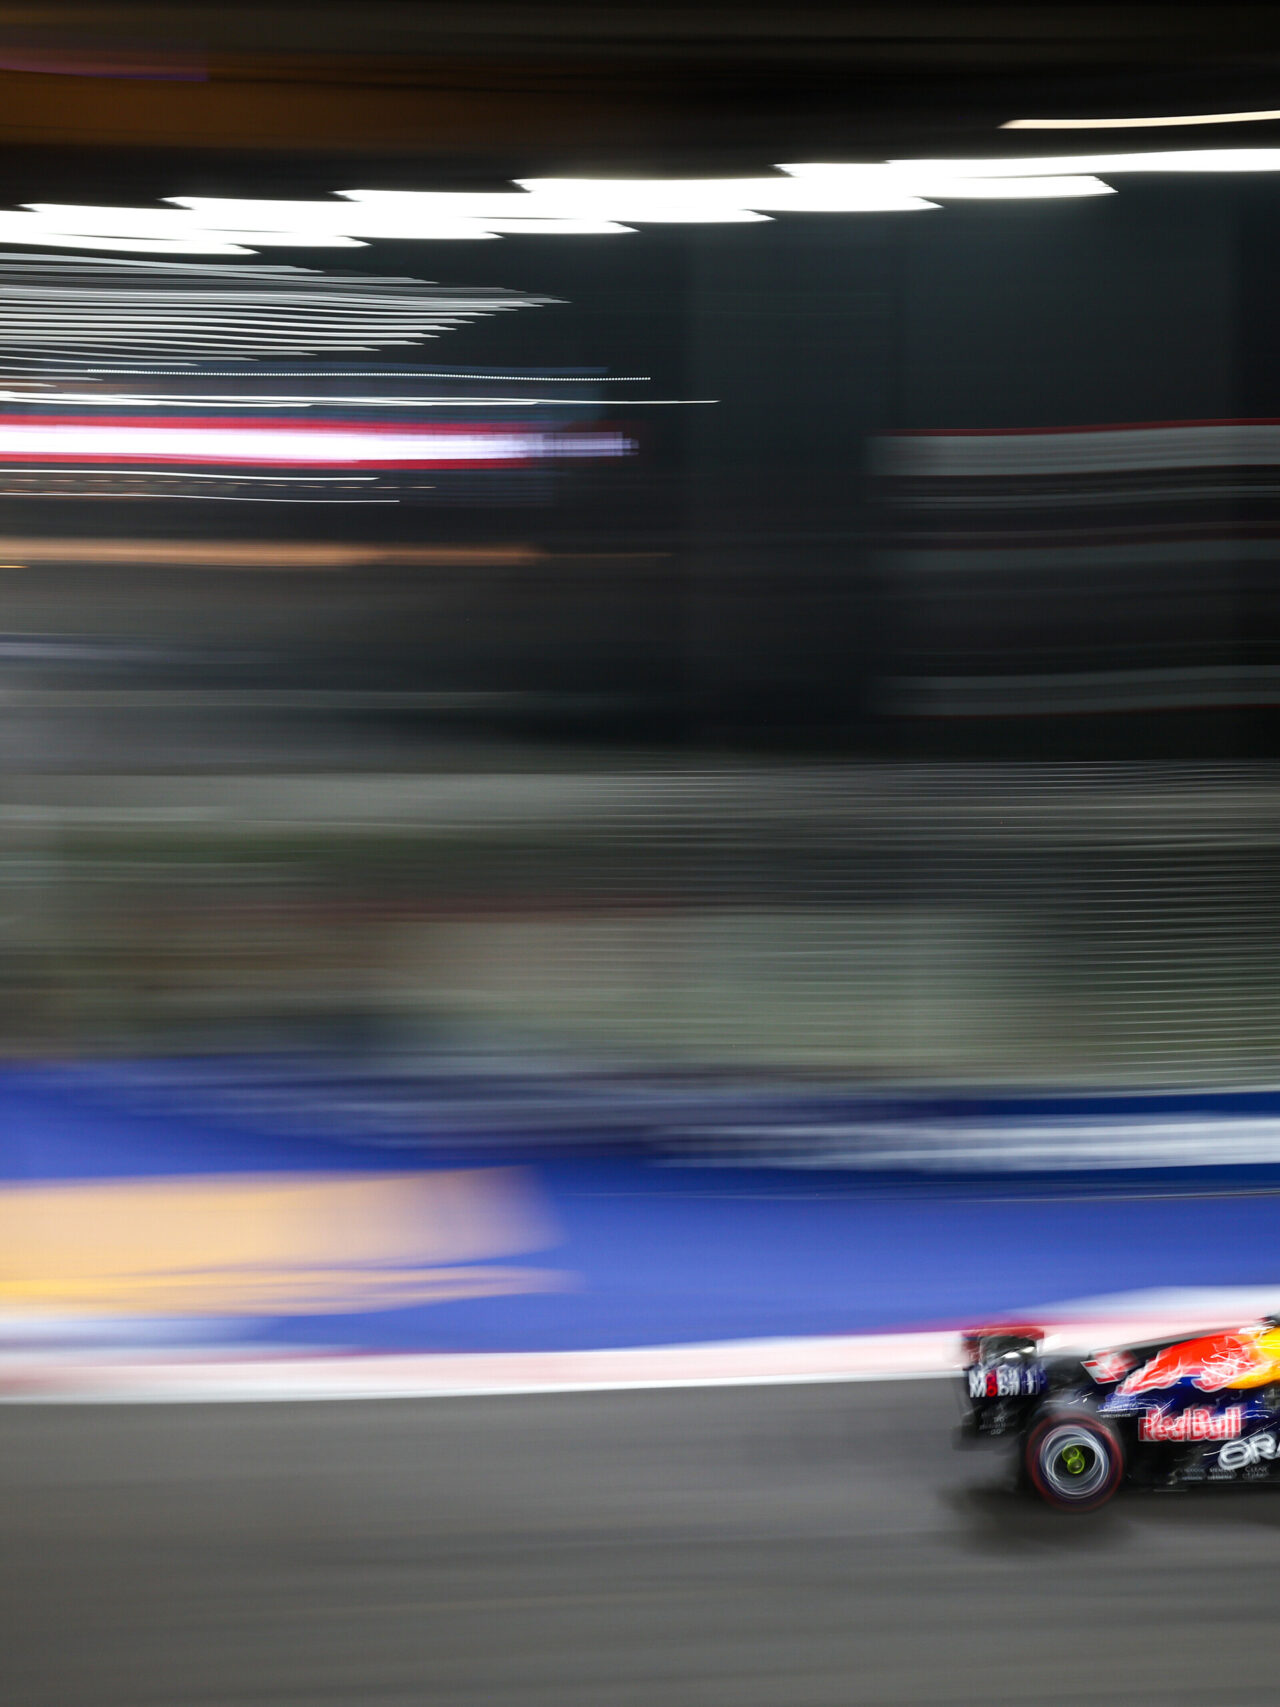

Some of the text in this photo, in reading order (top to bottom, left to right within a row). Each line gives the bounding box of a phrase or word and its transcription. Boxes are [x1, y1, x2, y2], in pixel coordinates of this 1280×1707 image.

[968, 1366, 1020, 1398] Mobil
[1138, 1407, 1242, 1442] Red Bull
